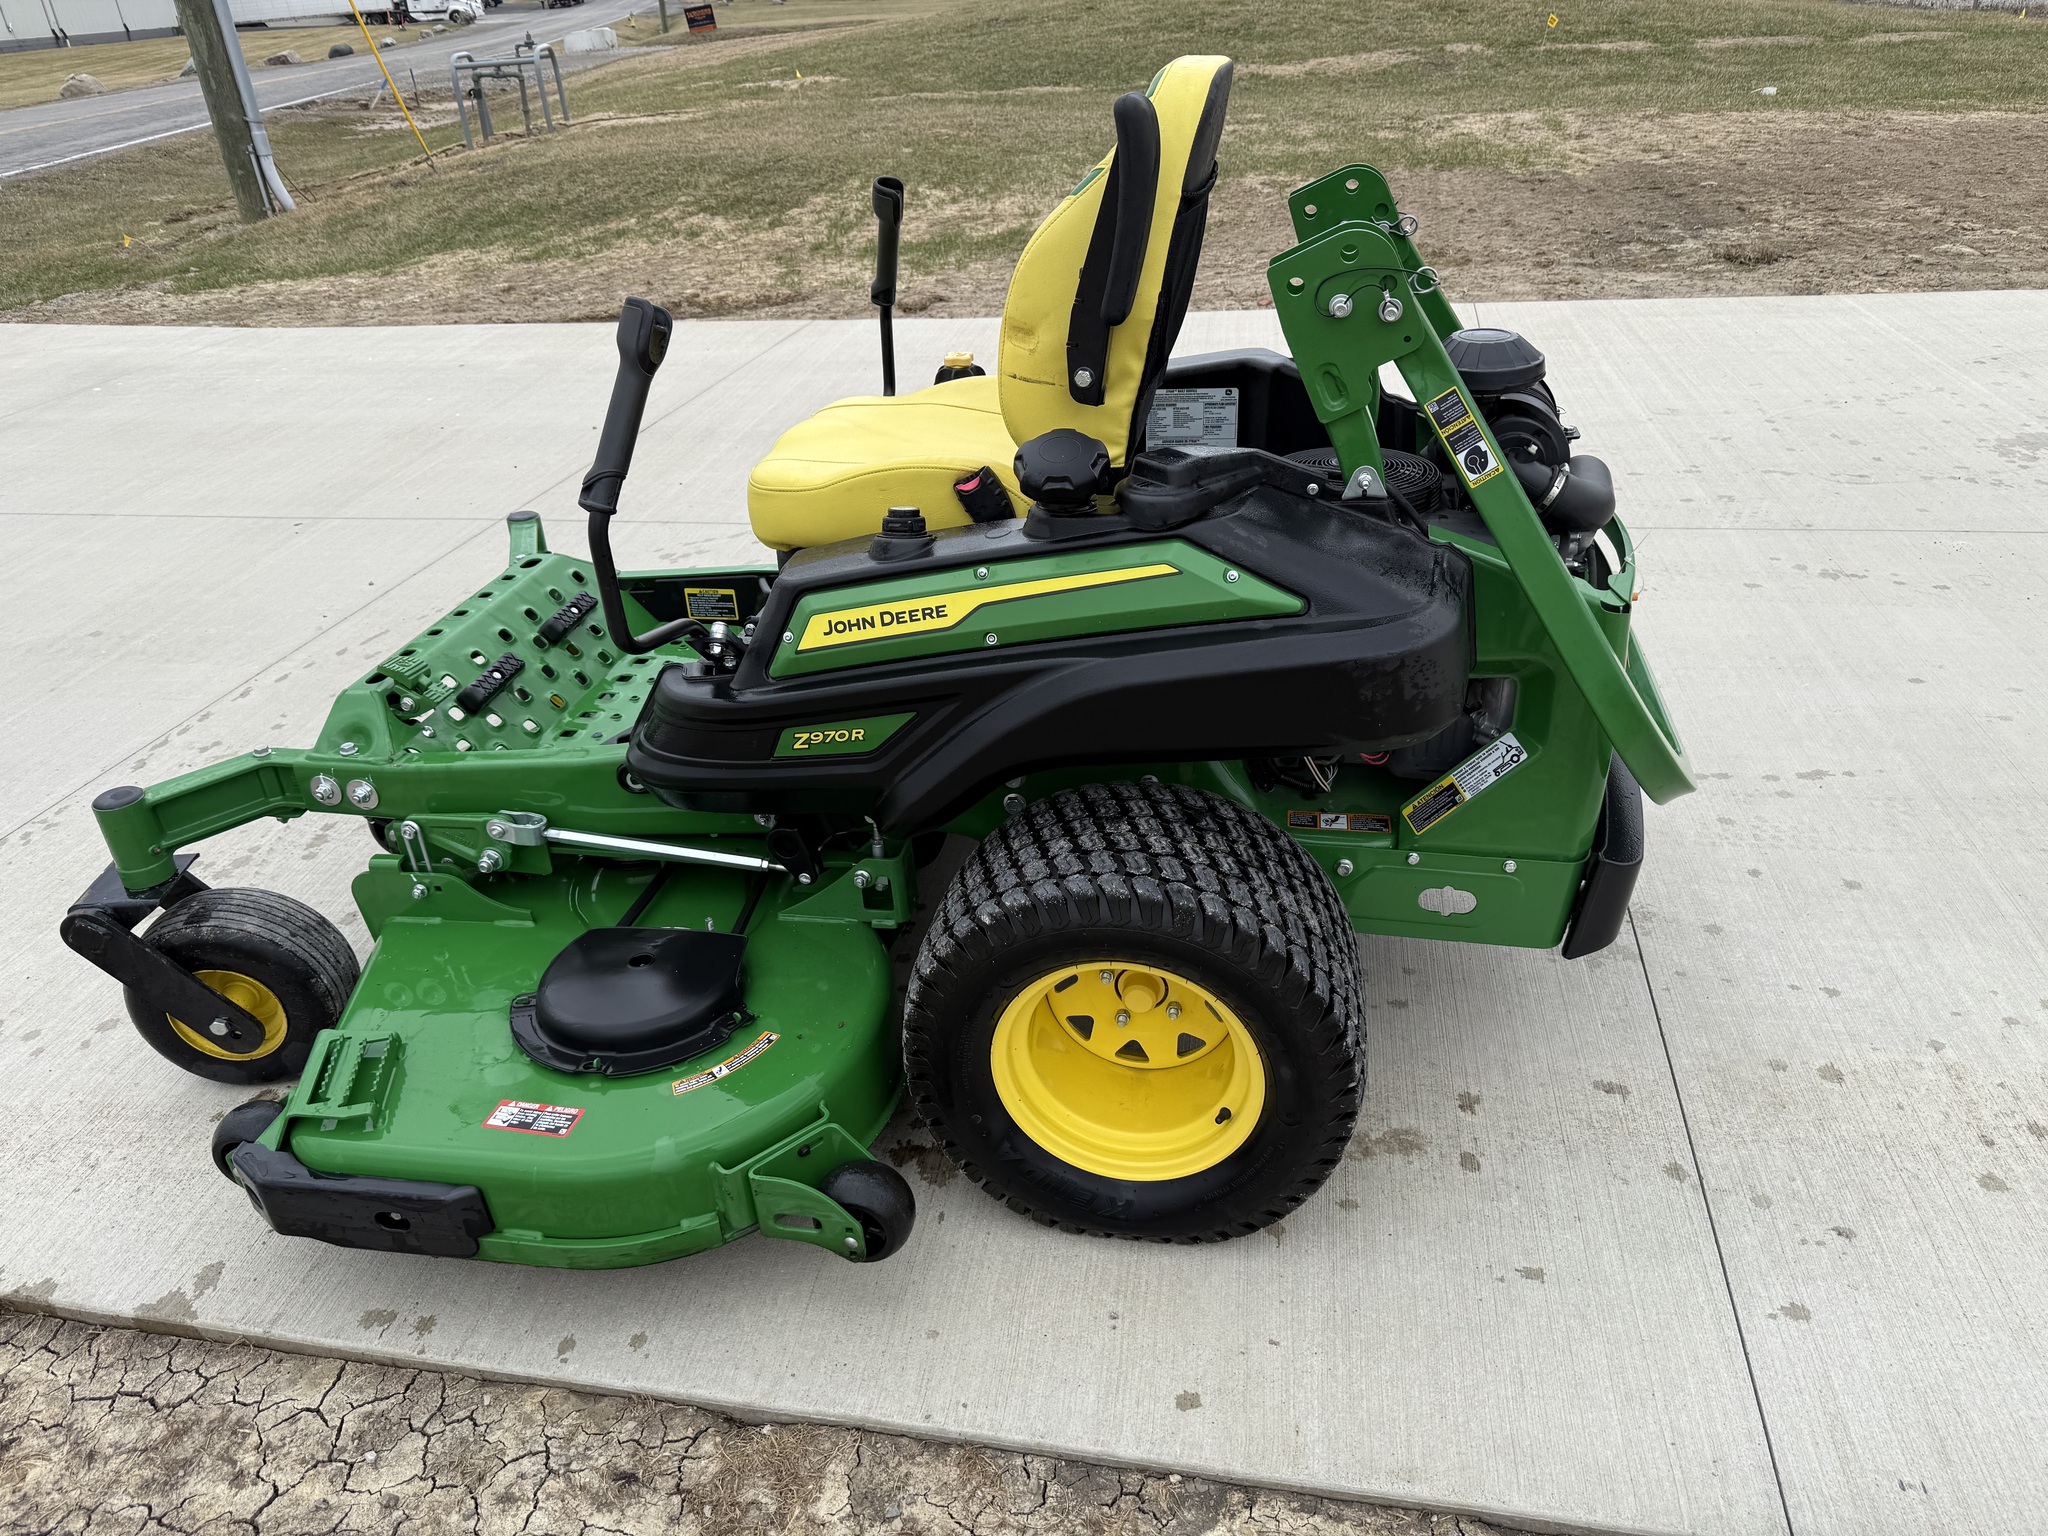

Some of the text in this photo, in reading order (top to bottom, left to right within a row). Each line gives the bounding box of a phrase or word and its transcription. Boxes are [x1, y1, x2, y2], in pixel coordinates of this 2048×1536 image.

[1472, 469, 1497, 487] CAUTION
[823, 604, 948, 636] JOHN DEERE
[792, 728, 866, 750] Z970R
[1417, 783, 1445, 805] ATENCIÓN
[516, 1101, 579, 1114] DANGER PELIGRO
